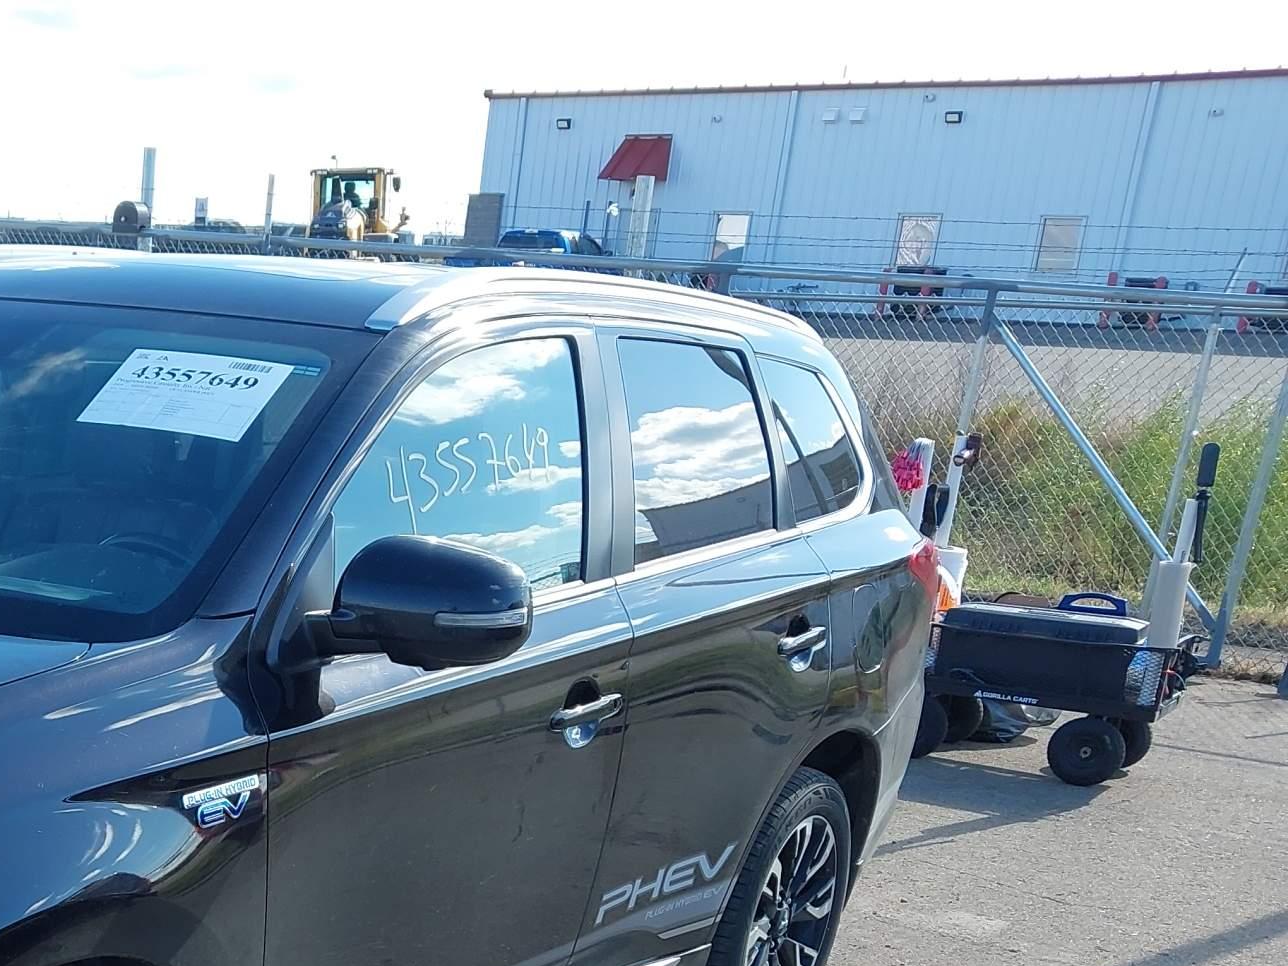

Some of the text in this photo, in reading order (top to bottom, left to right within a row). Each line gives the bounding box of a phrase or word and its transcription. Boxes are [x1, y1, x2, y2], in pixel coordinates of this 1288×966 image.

[131, 364, 260, 390] 43557649
[385, 422, 552, 536] 43557649
[983, 691, 1038, 704] GORILLA CARTS
[187, 777, 256, 805] PLUG-IN HYBRID
[197, 790, 251, 829] EV
[594, 841, 738, 928] PHEV
